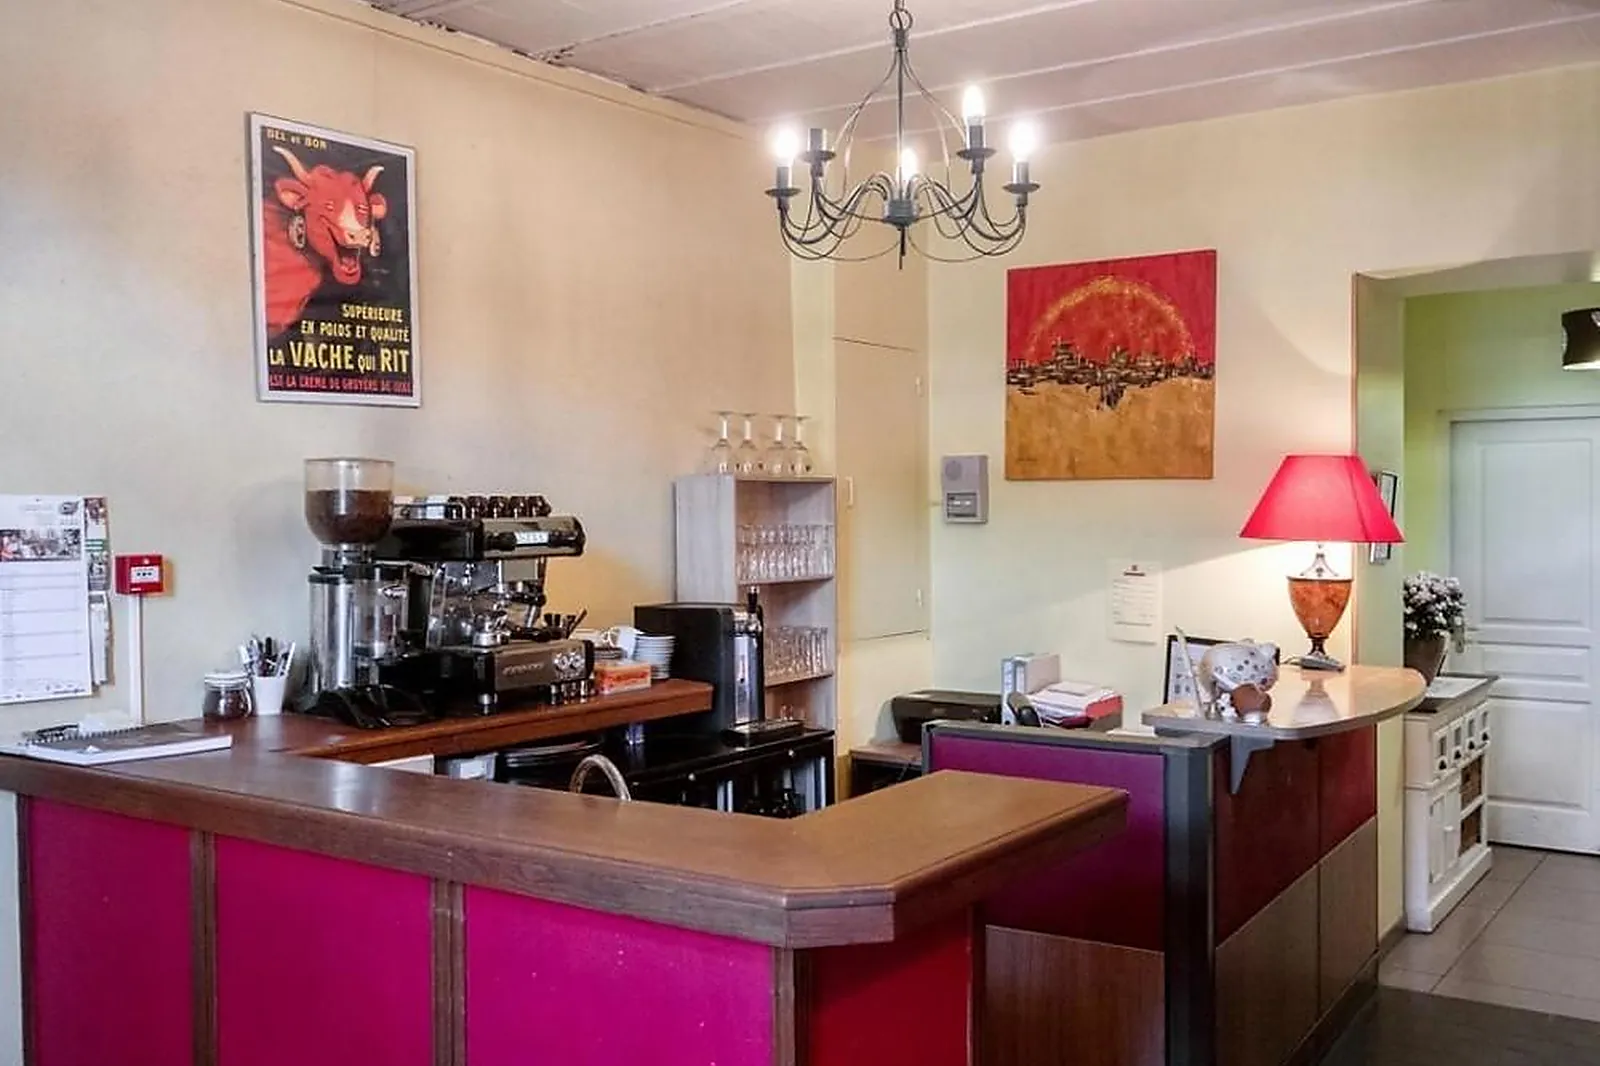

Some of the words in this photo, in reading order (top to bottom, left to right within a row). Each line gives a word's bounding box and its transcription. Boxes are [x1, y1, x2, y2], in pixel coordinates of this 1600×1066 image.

[304, 136, 327, 150] BON
[300, 320, 314, 334] EN
[355, 325, 367, 339] ET
[269, 348, 285, 366] LA
[289, 340, 355, 370] VACHE
[358, 353, 376, 374] QUI
[379, 345, 410, 373] RIT
